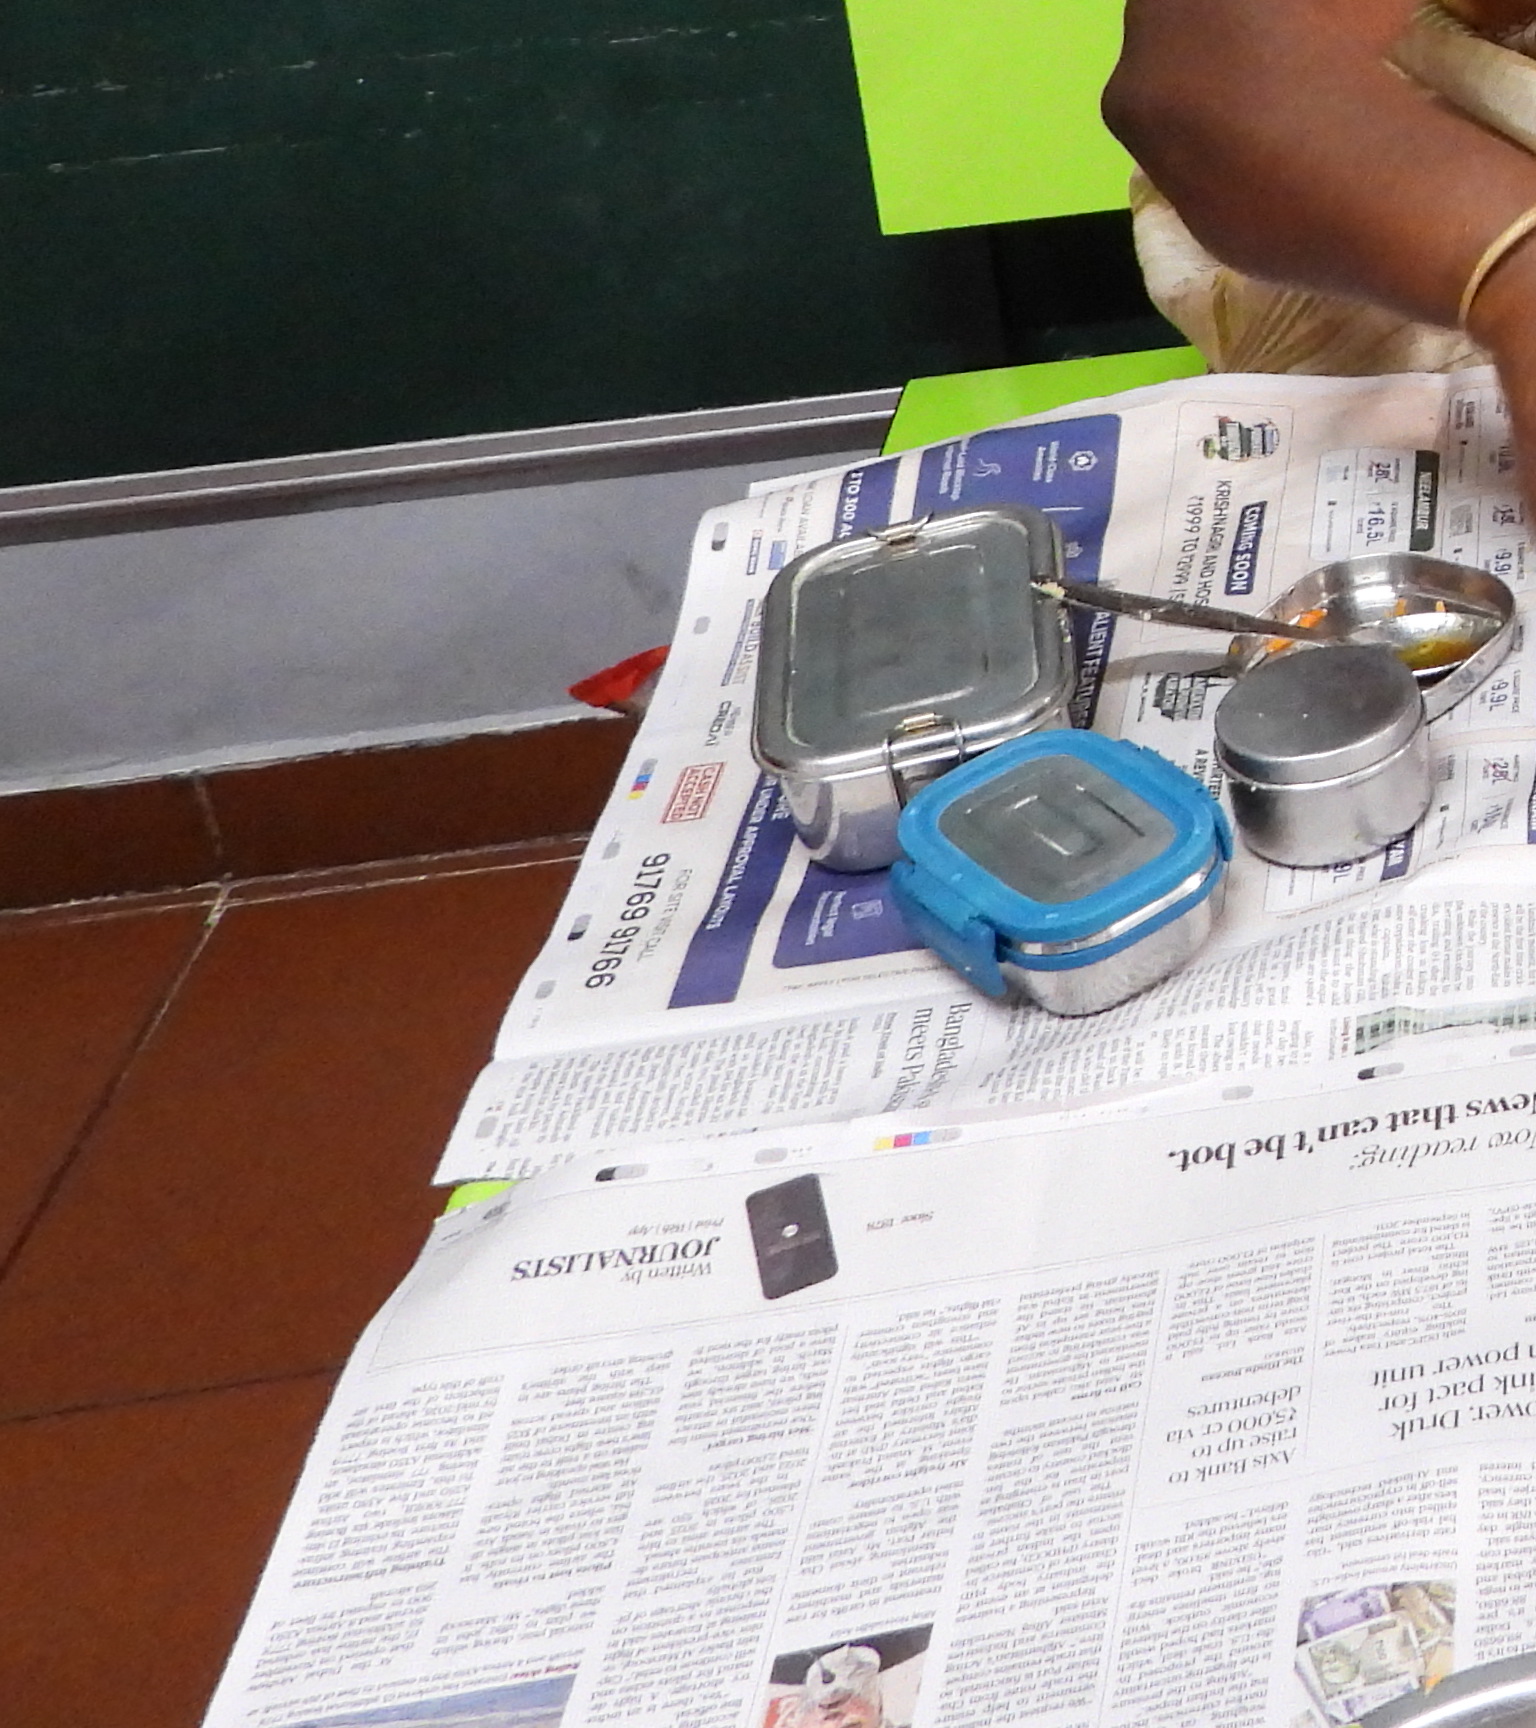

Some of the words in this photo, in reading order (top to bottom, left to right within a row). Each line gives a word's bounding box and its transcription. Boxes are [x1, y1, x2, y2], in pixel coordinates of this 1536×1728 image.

[1236, 505, 1261, 551] COMING
[1180, 536, 1199, 553] TO
[1198, 554, 1218, 579] AND
[1229, 552, 1251, 591] SOON
[1192, 579, 1212, 607] HOS
[619, 852, 670, 930] 91769
[584, 916, 640, 989] 91766
[904, 1006, 933, 1061] meets
[1387, 1103, 1455, 1132] that
[1243, 1134, 1285, 1160] be
[1296, 1115, 1378, 1153] can't
[1167, 1142, 1235, 1172] bot.
[1347, 1134, 1479, 1171] reading:
[512, 1236, 720, 1278] JOURNALISTS
[648, 1261, 711, 1278] Written
[619, 1265, 643, 1285] by
[1433, 1340, 1521, 1375] power
[1372, 1363, 1424, 1386] unit
[1427, 1372, 1484, 1403] pact
[1493, 1371, 1535, 1395] ink
[1186, 1384, 1301, 1416] debentures
[1377, 1391, 1417, 1411] for
[1201, 1421, 1223, 1436] cr
[1226, 1406, 1297, 1433] ₹5,000
[1391, 1408, 1459, 1441] Druk
[1165, 1427, 1194, 1444] via
[1216, 1436, 1244, 1453] up
[1248, 1425, 1297, 1447] raise
[1190, 1443, 1212, 1458] to
[1250, 1448, 1296, 1470] Axis
[1167, 1469, 1189, 1484] to
[1195, 1457, 1246, 1482] Bank
